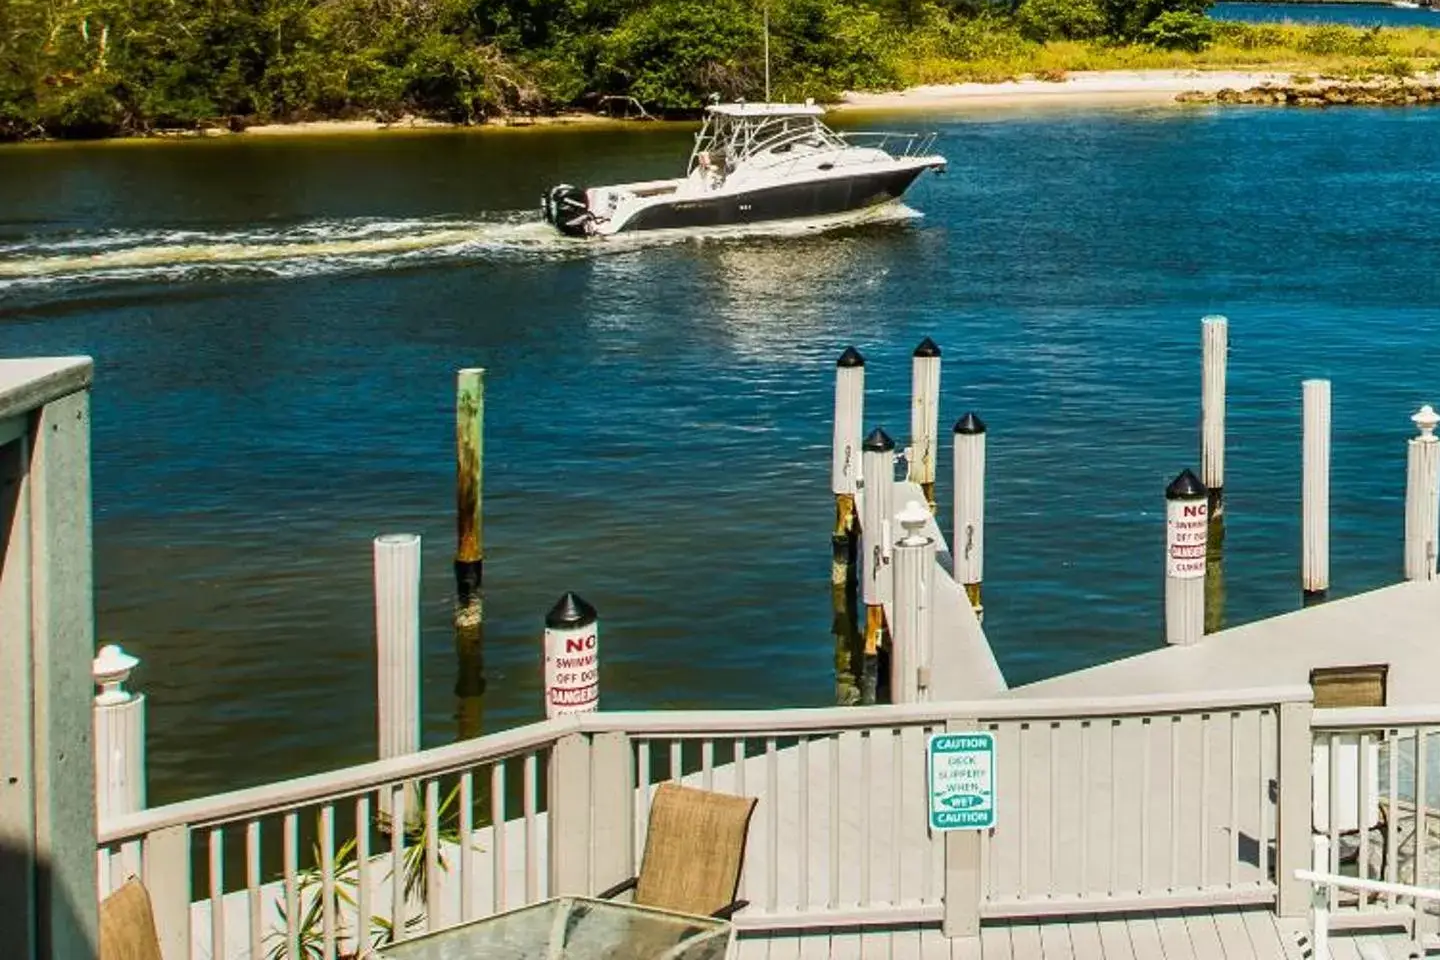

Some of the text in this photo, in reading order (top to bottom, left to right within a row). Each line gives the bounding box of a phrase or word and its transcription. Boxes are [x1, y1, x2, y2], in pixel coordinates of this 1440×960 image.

[1184, 504, 1206, 517] NO
[566, 635, 596, 654] NO
[556, 672, 577, 684] OFF
[936, 738, 988, 749] CAUTION
[947, 755, 976, 765] DECK
[938, 769, 985, 779] SLIPPERY
[946, 783, 978, 792] WHEN
[951, 796, 974, 808] WET
[937, 812, 988, 823] CAUTION
